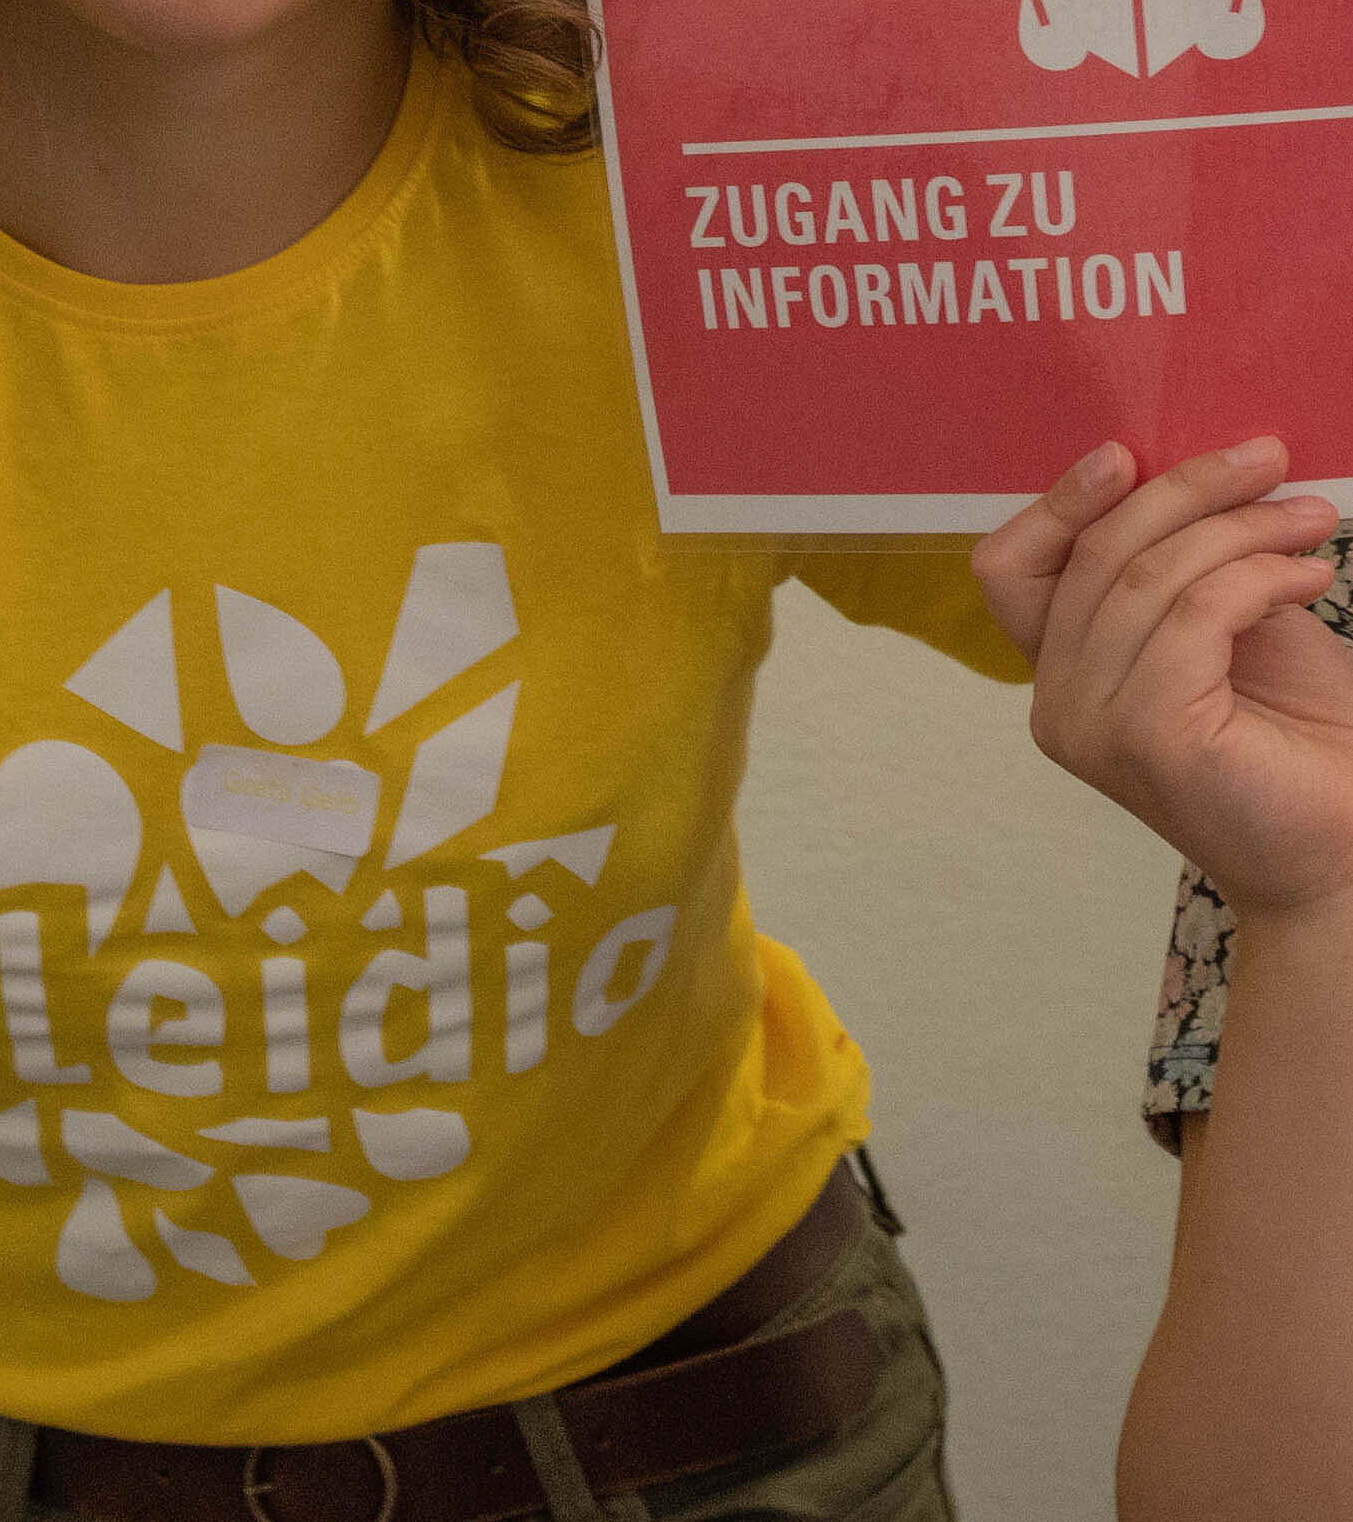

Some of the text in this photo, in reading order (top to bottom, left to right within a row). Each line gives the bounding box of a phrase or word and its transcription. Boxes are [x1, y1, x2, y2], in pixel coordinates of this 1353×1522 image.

[685, 170, 1077, 248] ZUGANG ZU
[697, 251, 1187, 330] INFORMATION
